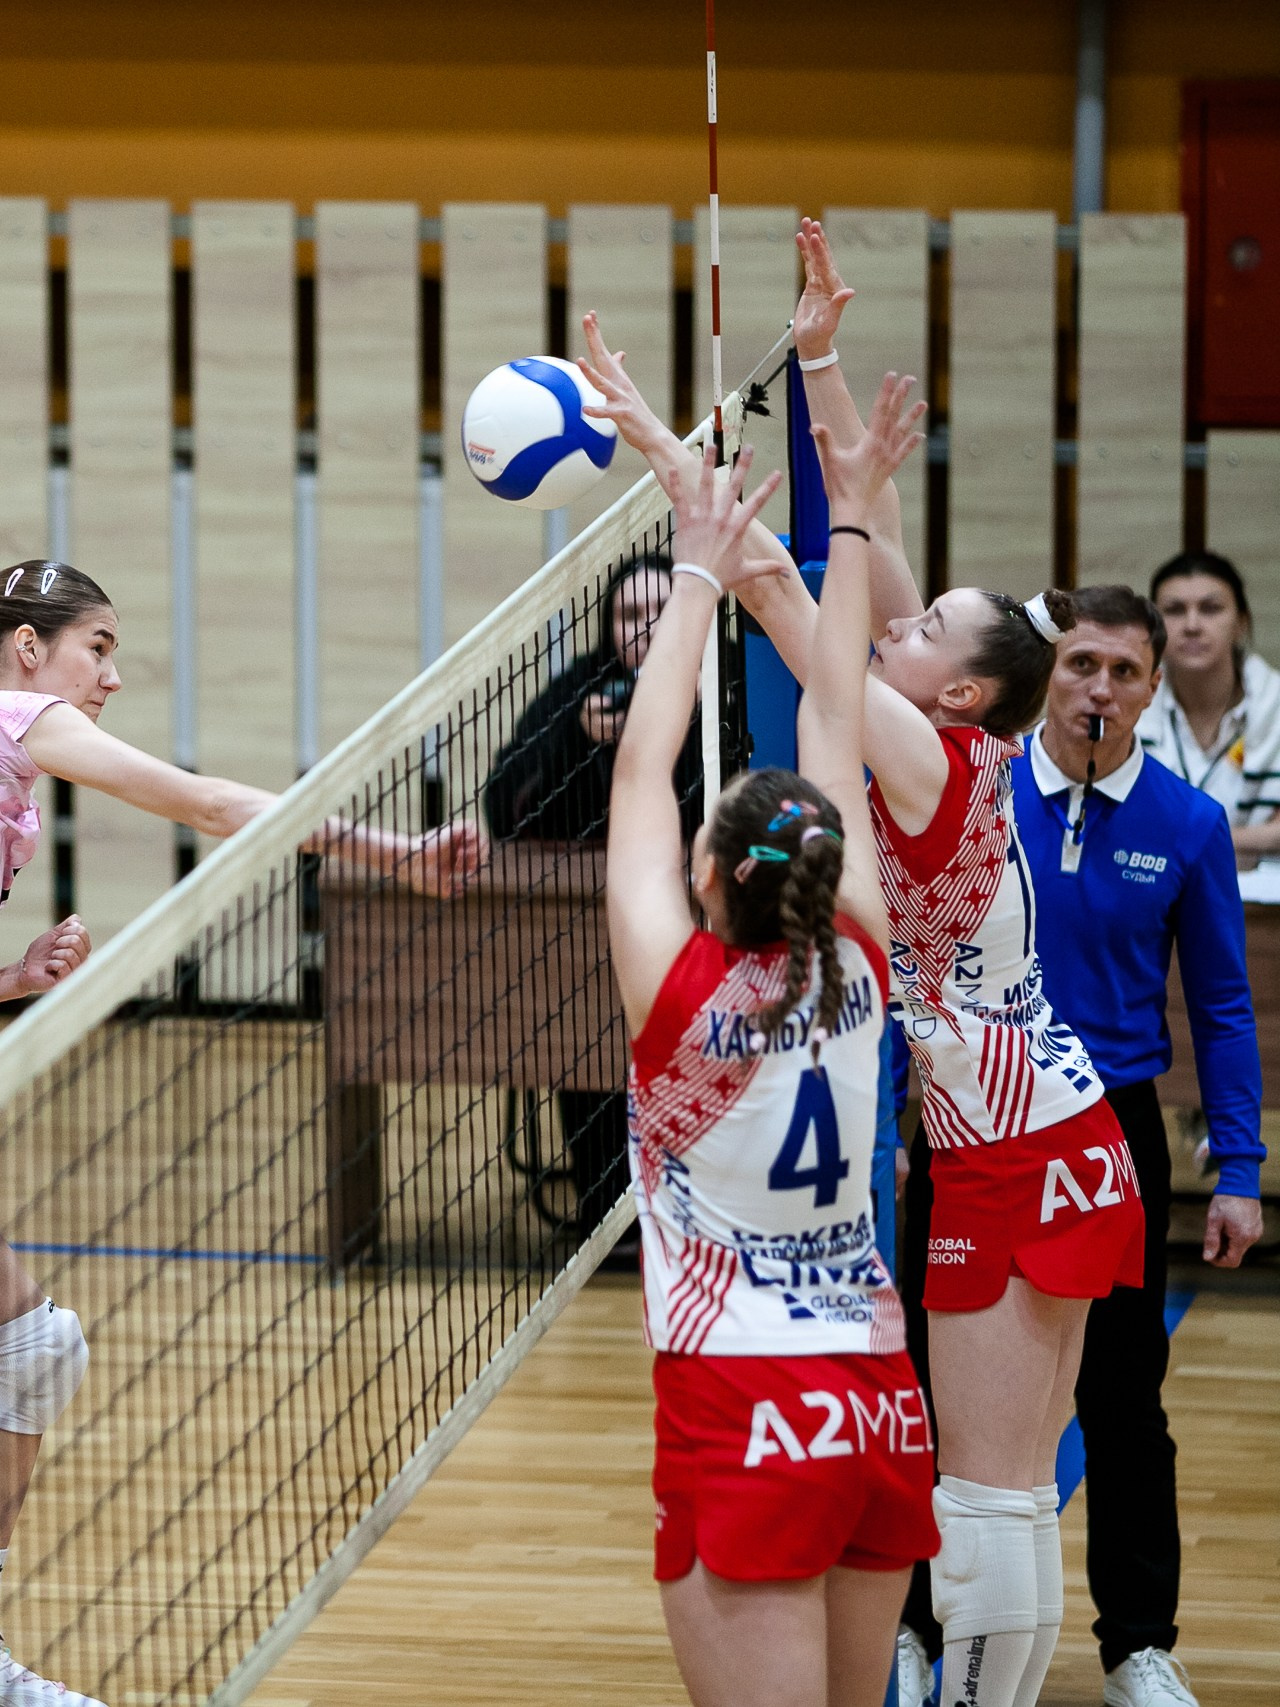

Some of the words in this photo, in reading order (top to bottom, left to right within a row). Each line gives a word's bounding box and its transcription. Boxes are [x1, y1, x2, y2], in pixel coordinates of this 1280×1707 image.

[1128, 851, 1167, 872] ВФВ
[889, 939, 937, 1040] A2MED
[954, 941, 989, 1019] A2ME
[767, 1064, 850, 1209] 4
[1039, 1139, 1141, 1224] A2M
